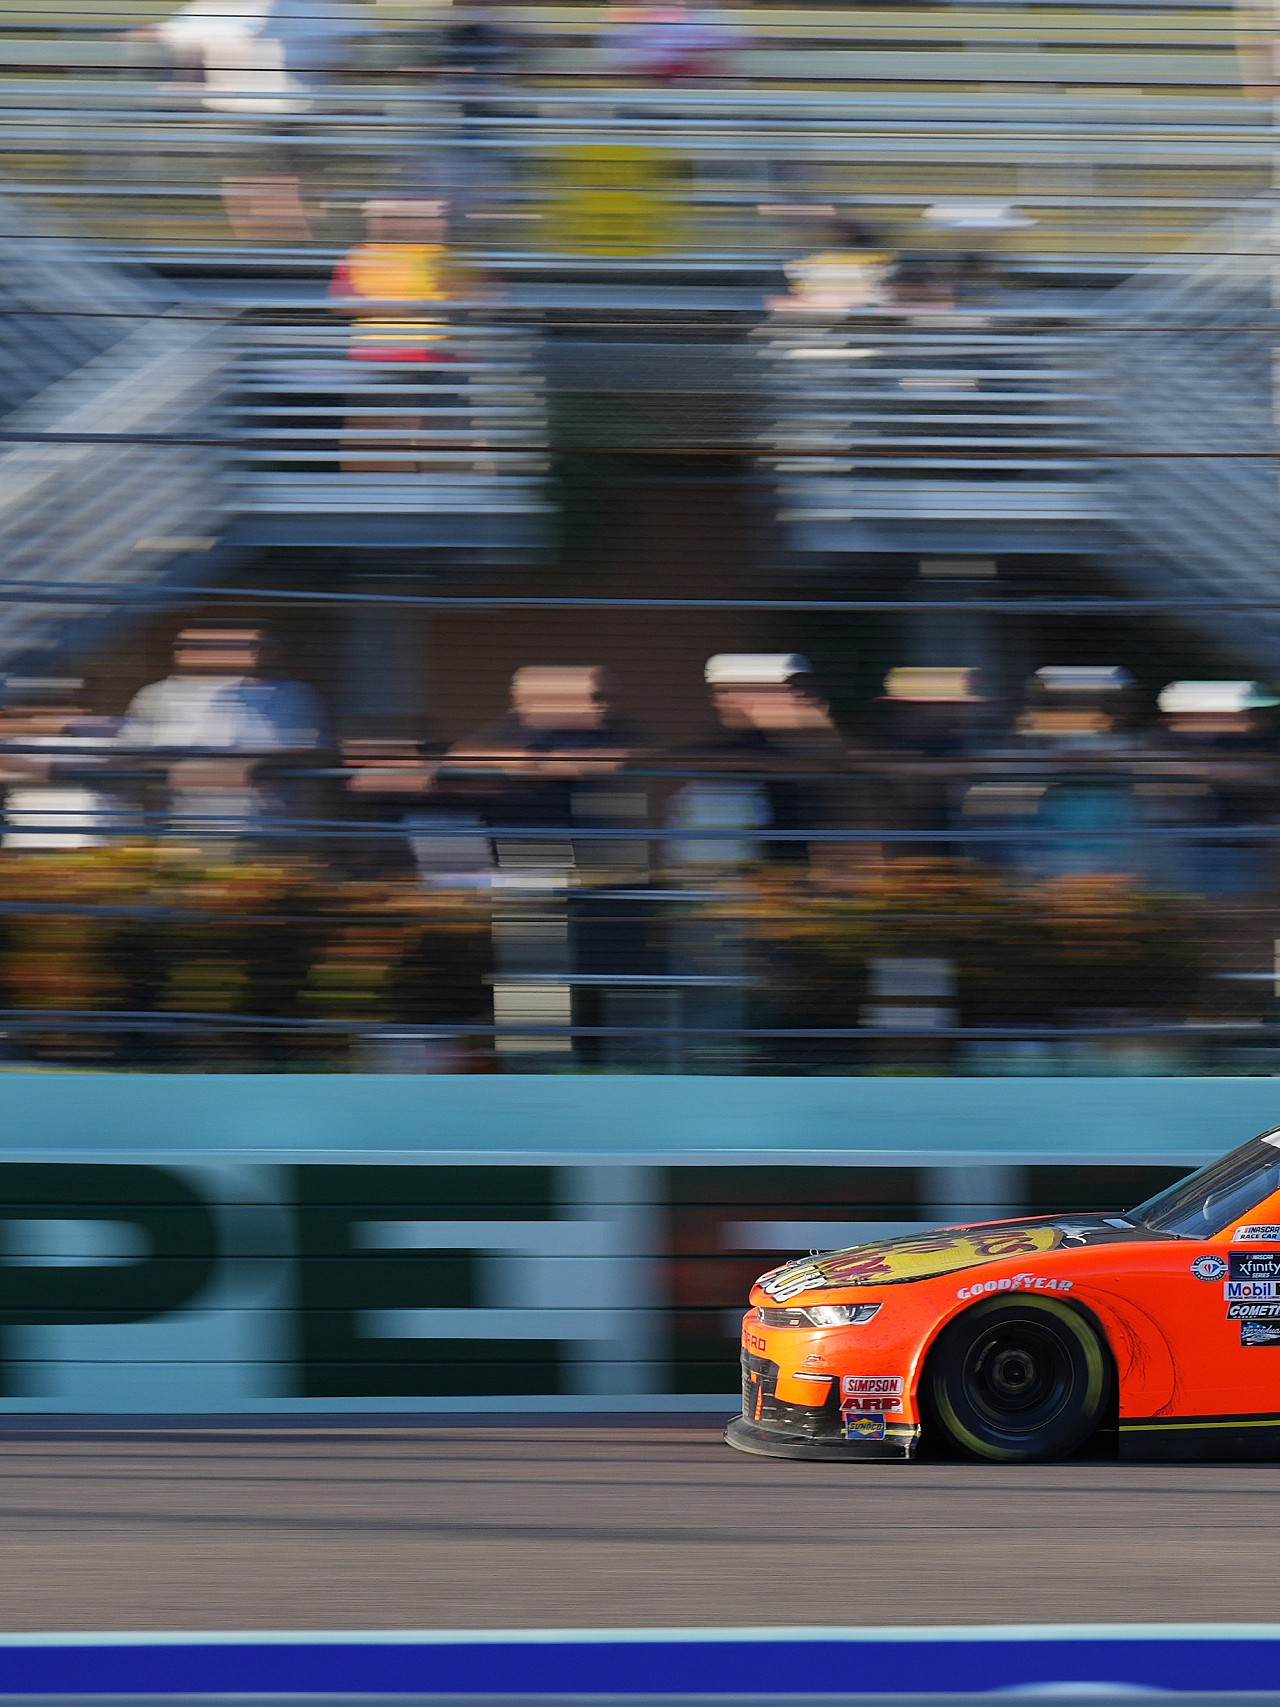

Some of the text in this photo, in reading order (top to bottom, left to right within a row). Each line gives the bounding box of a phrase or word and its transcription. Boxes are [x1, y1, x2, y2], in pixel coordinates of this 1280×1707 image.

[1250, 1226, 1280, 1234] NASCAR
[957, 1276, 1073, 1299] GOODYEAR
[1228, 1282, 1271, 1296] Mobil
[848, 1379, 899, 1393] SIMPSON
[842, 1398, 902, 1411] ARP
[848, 1421, 885, 1432] SUNOCO
